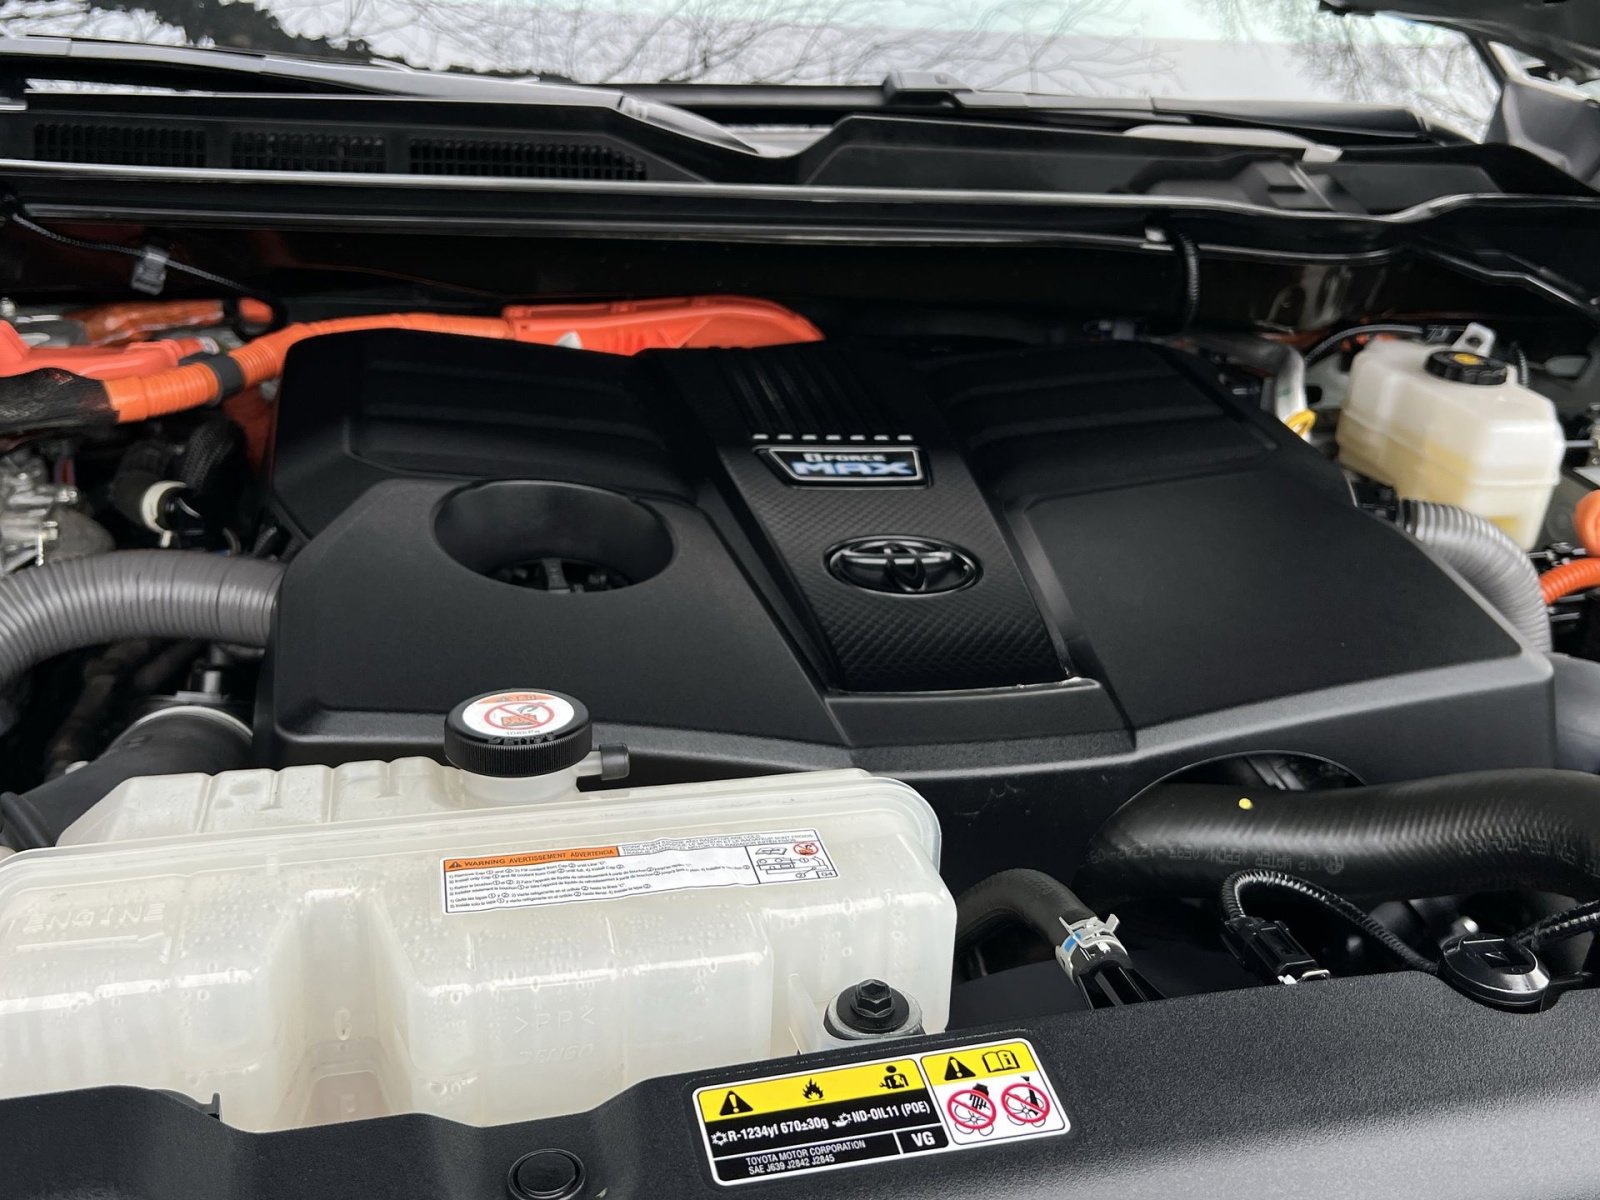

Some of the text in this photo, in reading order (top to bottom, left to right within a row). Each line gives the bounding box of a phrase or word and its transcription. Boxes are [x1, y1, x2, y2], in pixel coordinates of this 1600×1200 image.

[791, 461, 913, 475] MAX
[464, 849, 615, 866] WARNING AVERTISSEMENT ADVERTENCIA
[23, 903, 165, 933] ENGINE
[727, 1100, 931, 1142] R-1234yf 670±30g ND-OIL11 (POE)
[911, 1131, 936, 1147] VG
[746, 1140, 866, 1166] TOYOTA MOTOR CORPORATION
[748, 1154, 835, 1175] SAE J639 J2842 J2845
